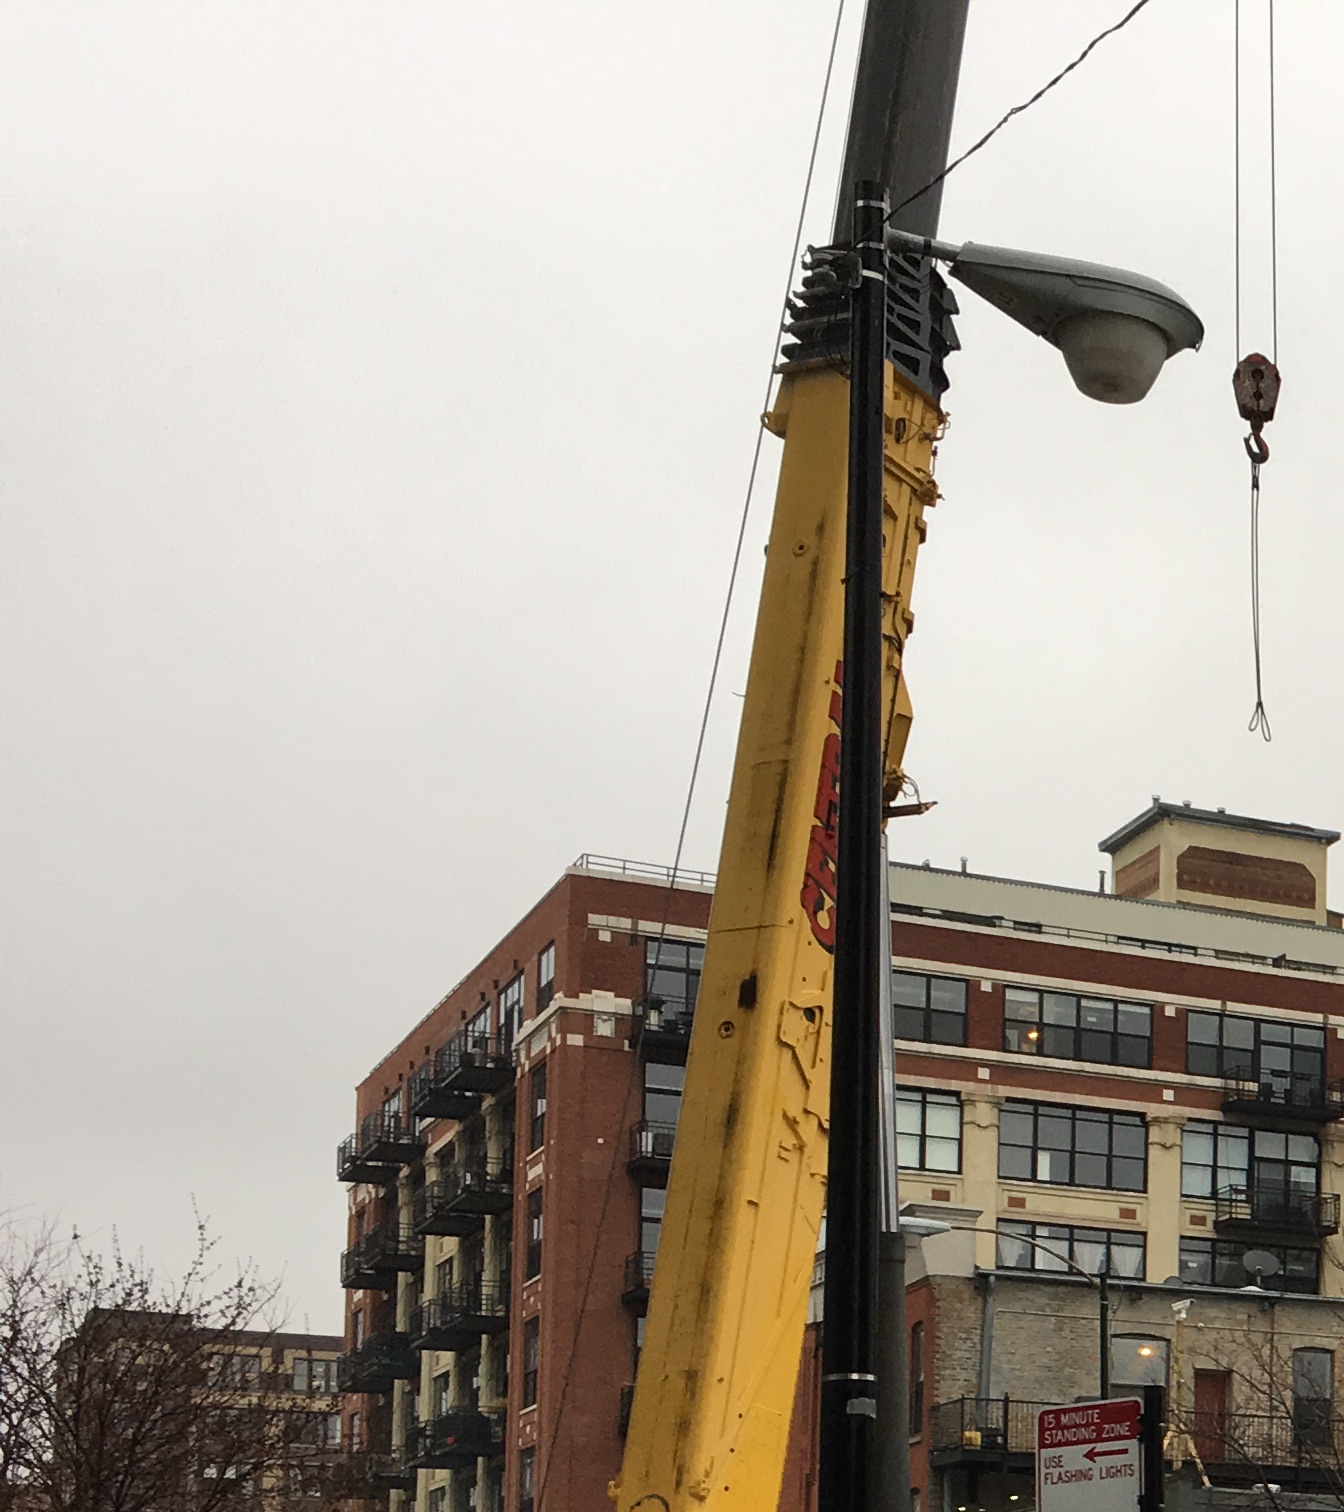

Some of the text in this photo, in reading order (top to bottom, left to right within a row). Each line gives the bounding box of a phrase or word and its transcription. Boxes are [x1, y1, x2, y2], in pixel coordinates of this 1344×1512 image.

[1044, 1410, 1100, 1428] 15 MINUTE
[1044, 1422, 1131, 1444] STANDING ZONE
[1044, 1455, 1064, 1469] USE
[1044, 1464, 1135, 1485] FLASHING LIGHTS
